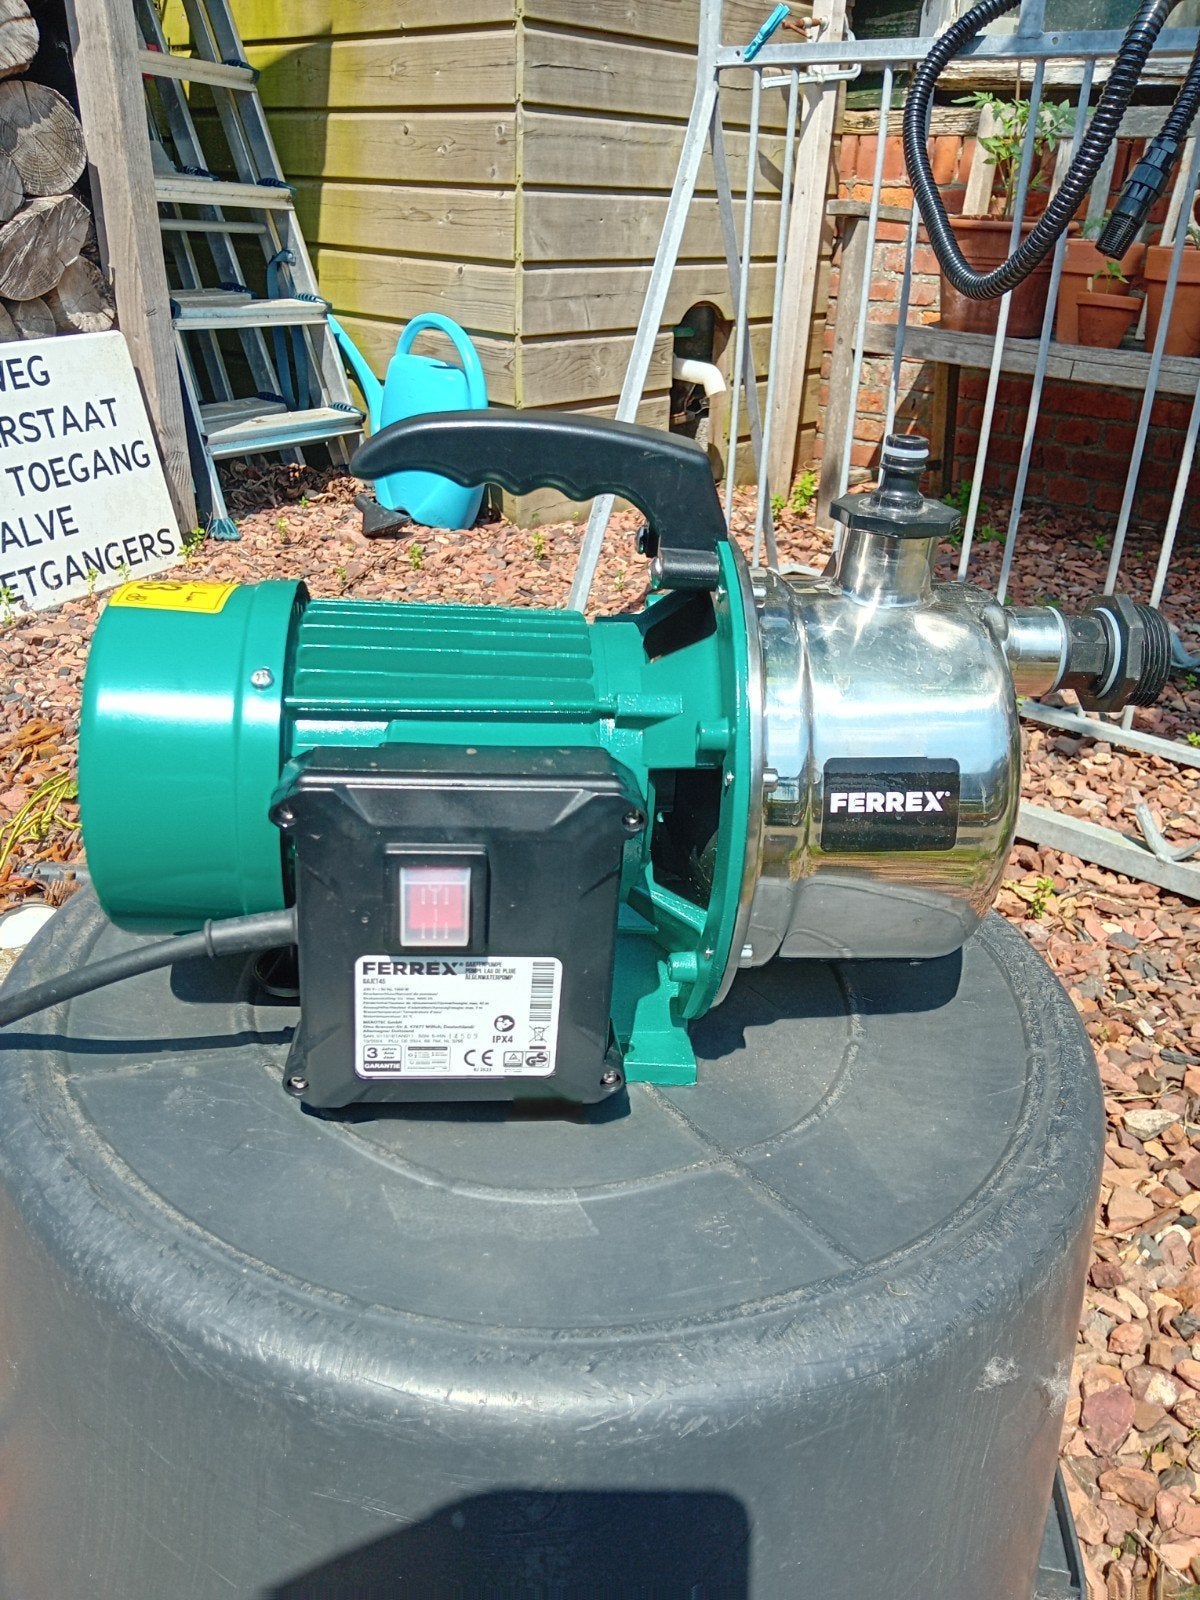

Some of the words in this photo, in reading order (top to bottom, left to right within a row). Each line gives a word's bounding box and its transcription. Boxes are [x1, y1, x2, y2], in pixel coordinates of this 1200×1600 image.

[0, 397, 117, 448] RSTAAT
[5, 440, 151, 497] TOEGANG
[1, 505, 79, 554] ALVE
[0, 528, 175, 603] ETGANGERS
[830, 791, 944, 813] FERREX
[362, 962, 457, 975] FERREX
[367, 1047, 378, 1058] 3
[492, 1035, 513, 1043] IPX4
